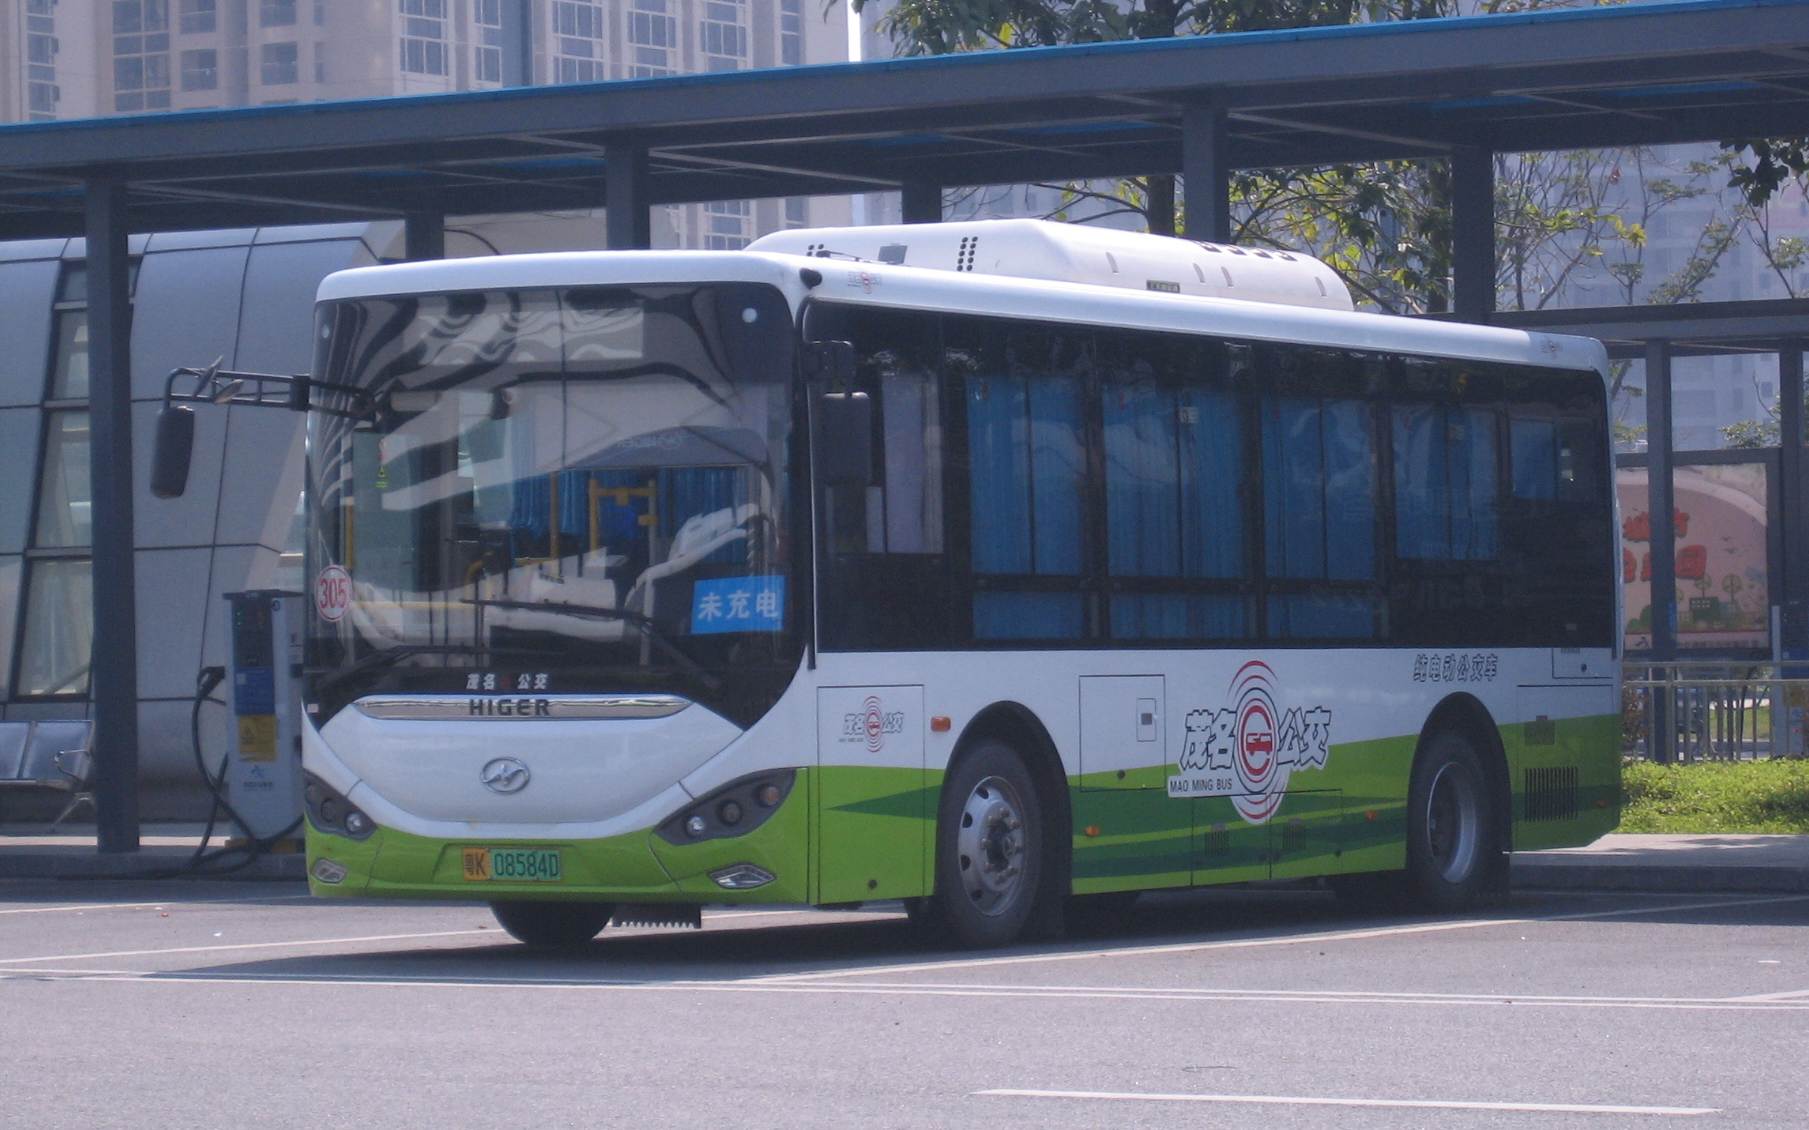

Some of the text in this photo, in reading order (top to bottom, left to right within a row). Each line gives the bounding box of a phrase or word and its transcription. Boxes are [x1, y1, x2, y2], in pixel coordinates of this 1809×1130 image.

[320, 578, 348, 609] 305
[697, 588, 779, 621] 未充电
[1413, 653, 1499, 682] 纯电动公交车
[517, 672, 549, 690] 公交
[469, 698, 550, 716] HIGER
[1179, 705, 1332, 771] 茂名 公交
[1170, 778, 1233, 792] MAO MING BUS
[494, 853, 559, 877] 08584D
